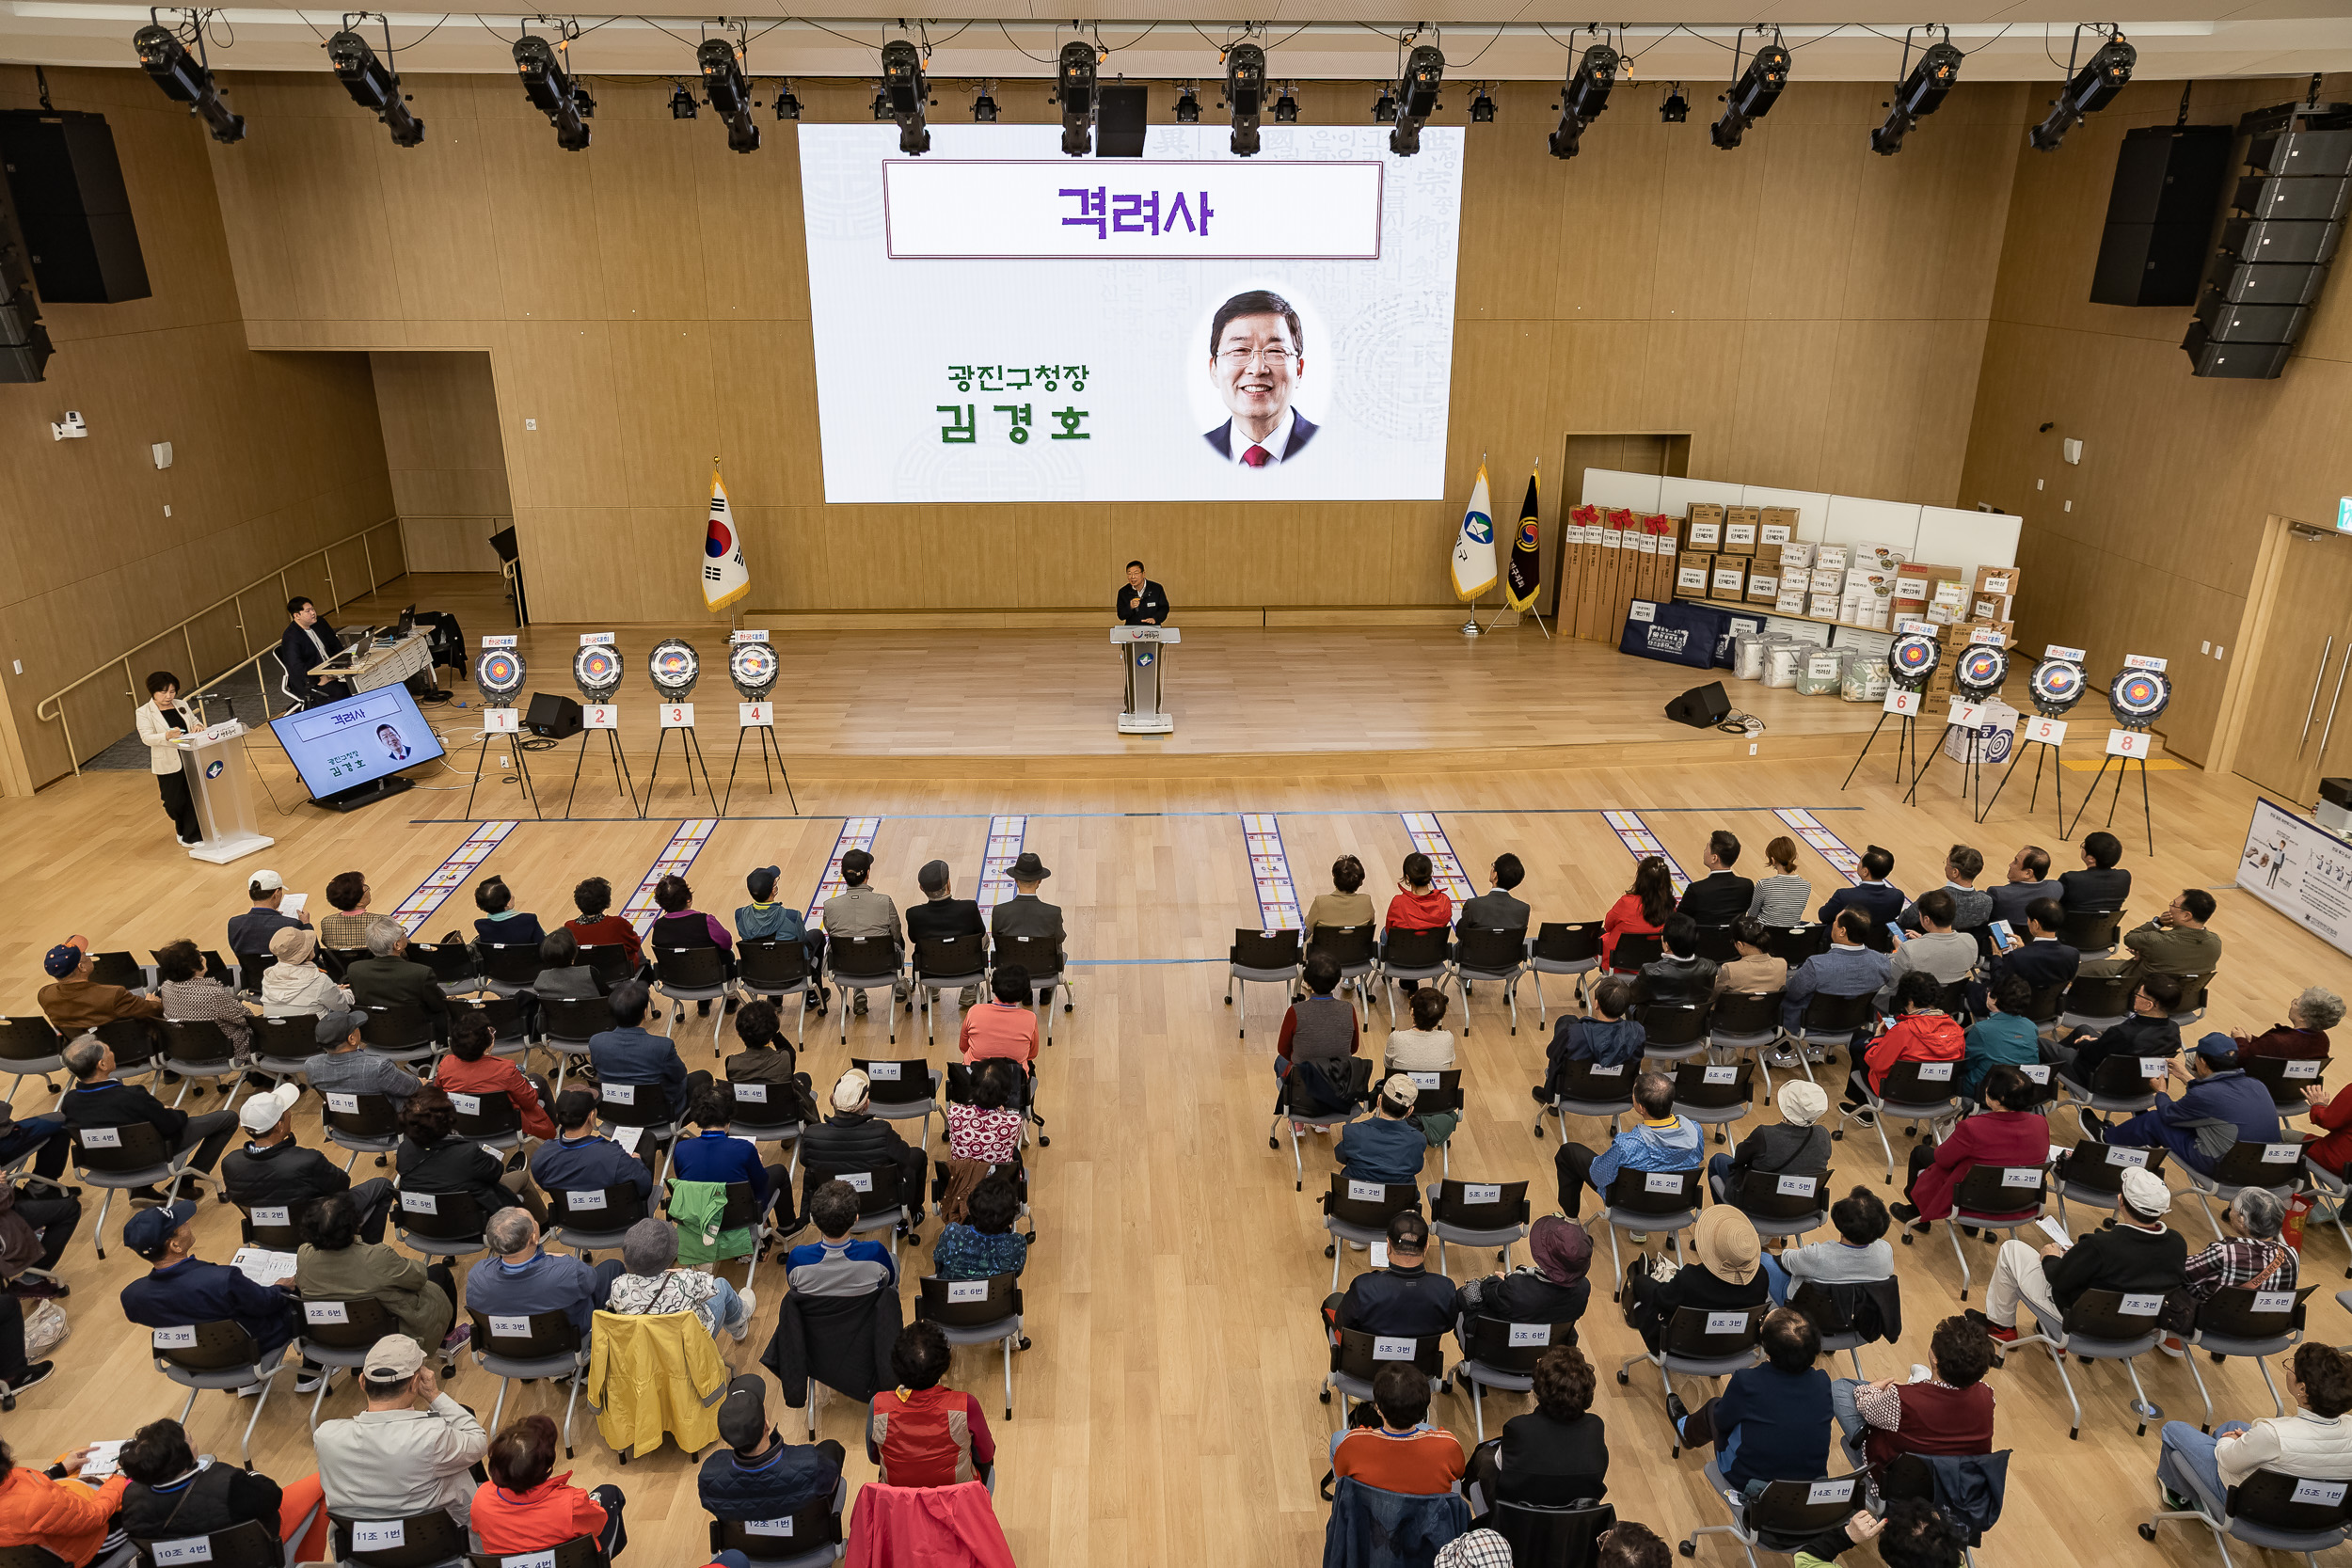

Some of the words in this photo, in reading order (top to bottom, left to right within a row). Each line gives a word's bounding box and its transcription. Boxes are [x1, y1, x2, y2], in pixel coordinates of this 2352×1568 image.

[1059, 186, 1214, 239] 격려사
[948, 365, 1089, 391] 광진구청장
[936, 404, 977, 443] 김
[993, 404, 1032, 444] 경
[1052, 406, 1090, 440] 호
[1908, 625, 1932, 634] 한궁대회
[1976, 635, 2000, 643] 한궁대회
[2052, 649, 2079, 658] 한궁대회
[2131, 658, 2160, 668] 한궁대회
[1897, 695, 1906, 708] 6
[331, 709, 365, 724] 격려사
[498, 714, 503, 726] 1
[596, 709, 605, 722] 2
[674, 709, 682, 721] 3
[752, 707, 760, 720] 4
[1963, 707, 1973, 720] 7
[2040, 723, 2052, 736] 5
[2122, 736, 2133, 751] 8
[327, 751, 358, 765] 광진구청장
[329, 767, 342, 777] 김
[342, 762, 353, 771] 경
[355, 760, 366, 768] 호
[158, 1332, 171, 1340] 2조
[2299, 1488, 2320, 1497] 15조
[2326, 1491, 2342, 1499] 1번
[748, 1519, 770, 1528] 12조
[774, 1519, 789, 1528] 1번
[357, 1531, 377, 1541] 11조
[384, 1529, 400, 1539] 1번
[158, 1548, 183, 1559] 10조
[189, 1544, 206, 1554] 4번
